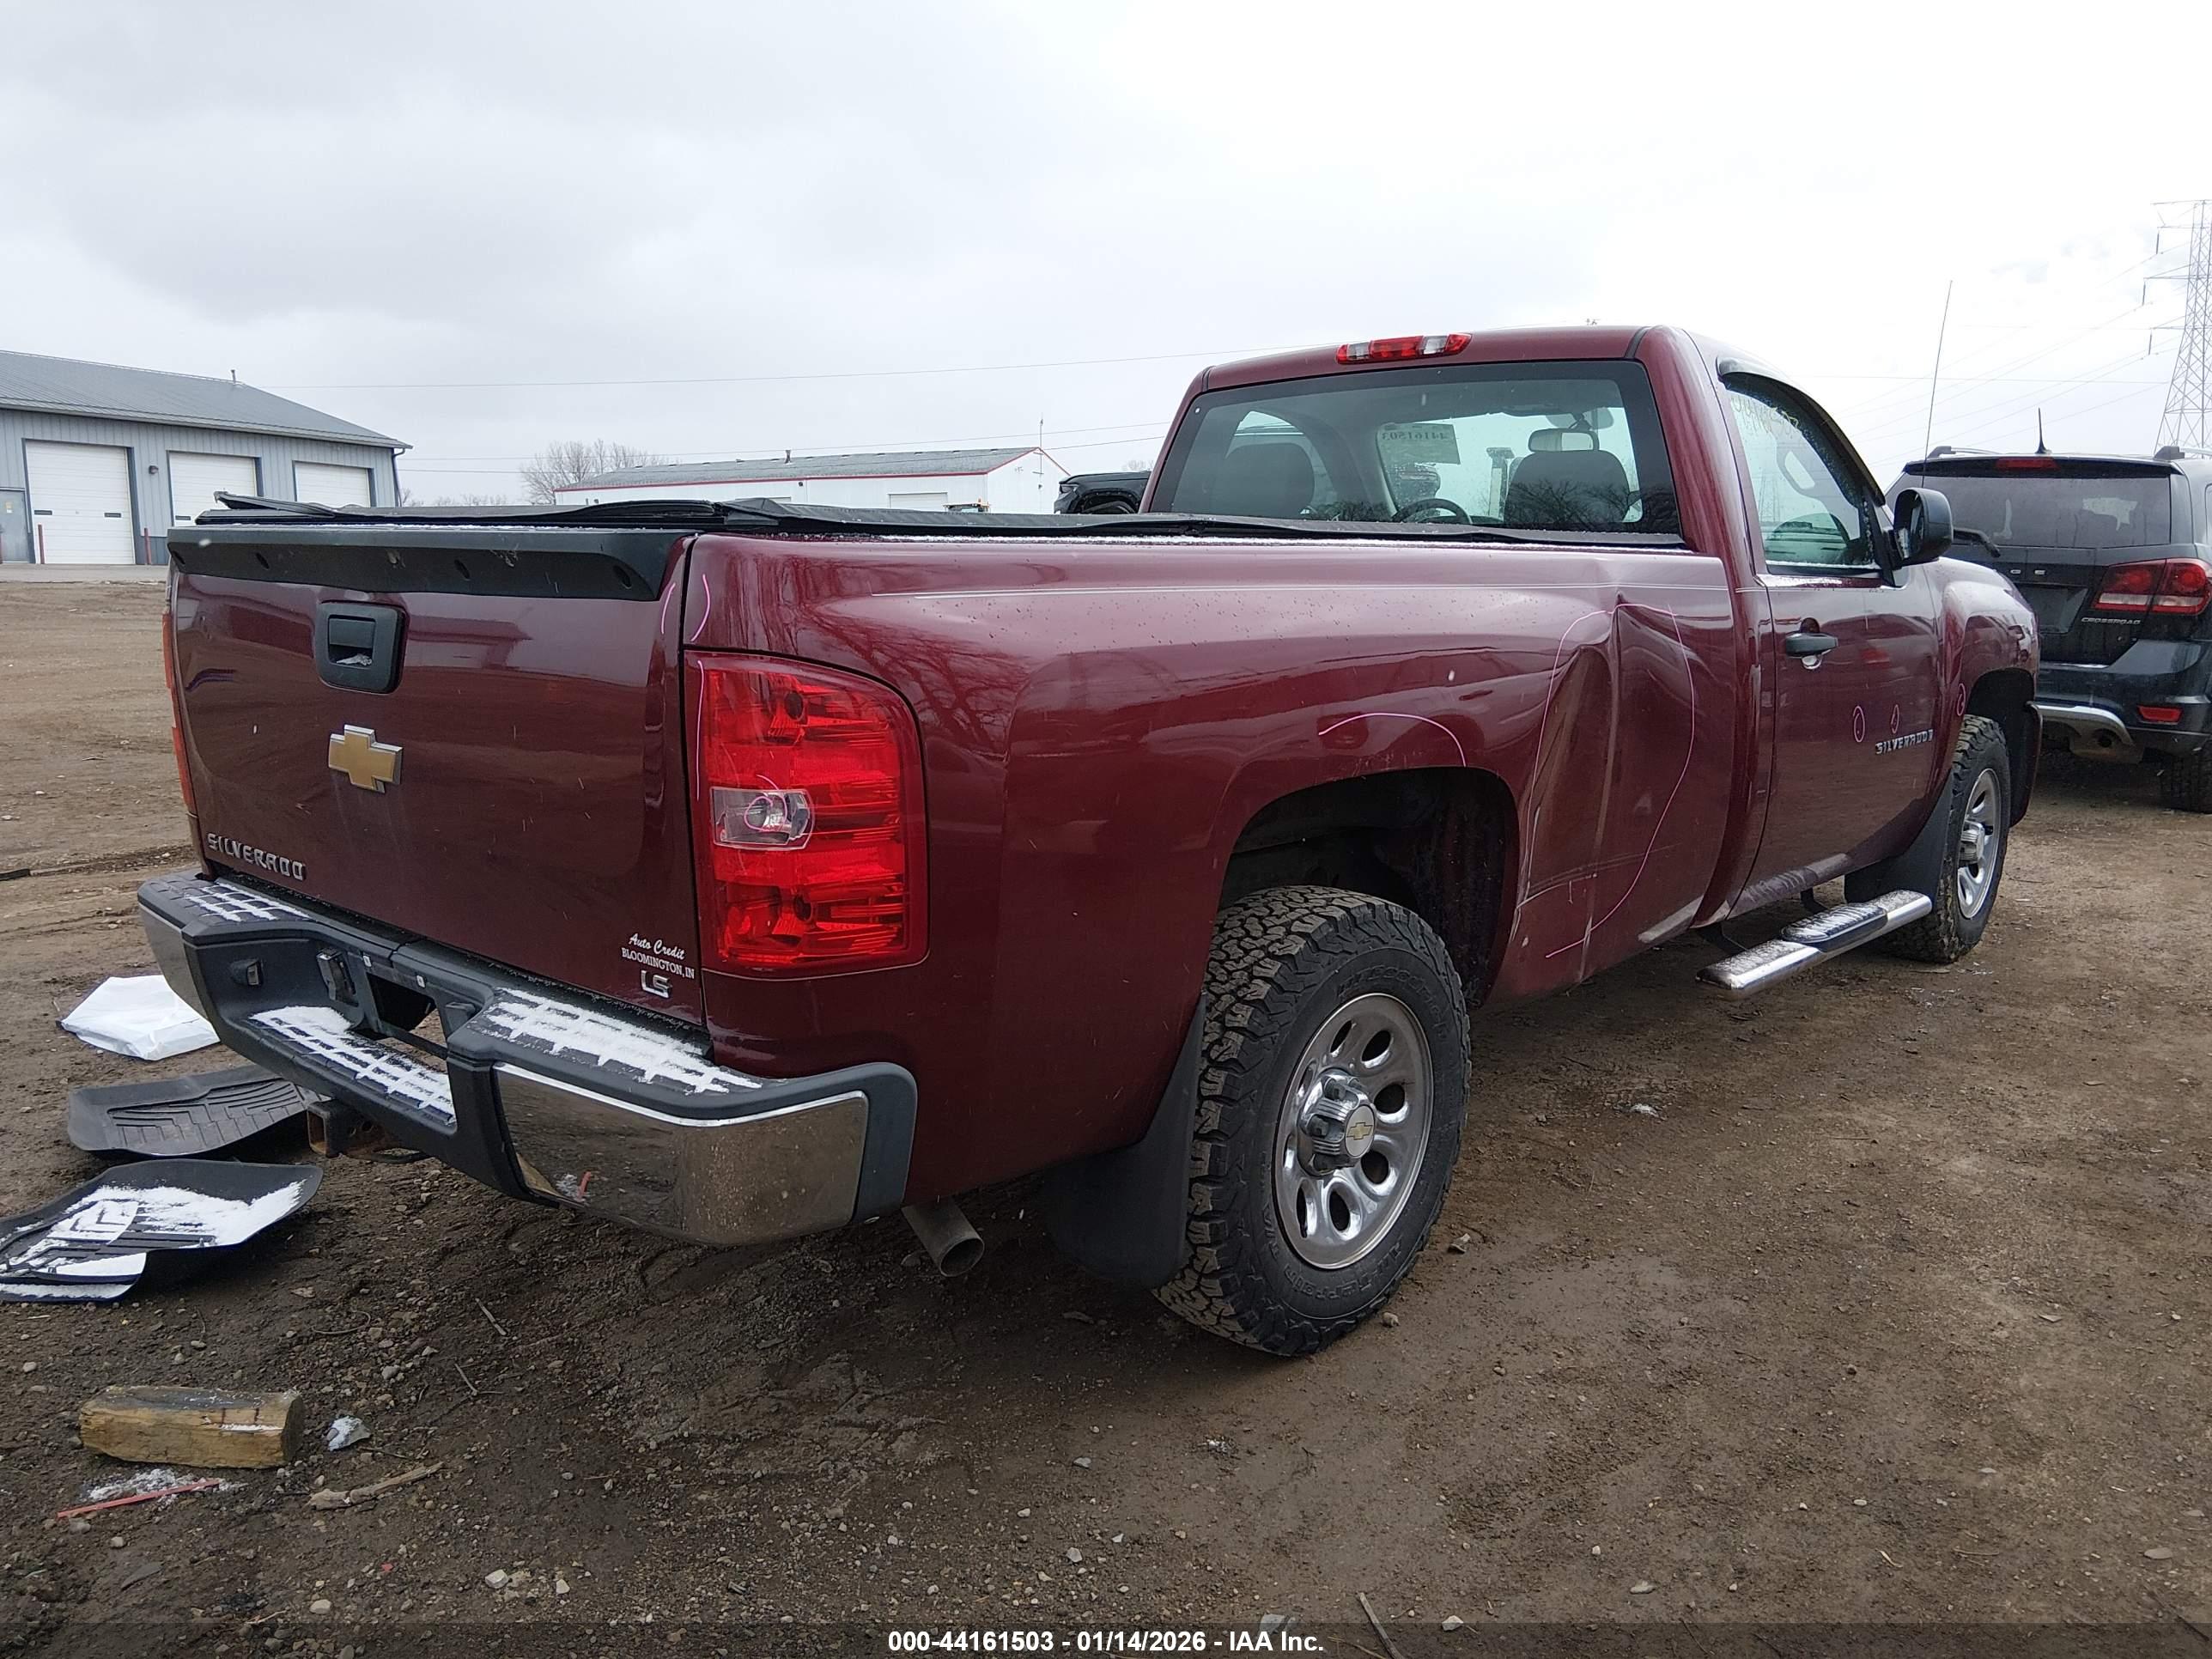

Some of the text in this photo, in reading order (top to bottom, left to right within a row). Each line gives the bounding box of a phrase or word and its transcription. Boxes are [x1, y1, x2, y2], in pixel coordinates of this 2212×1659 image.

[2081, 617, 2141, 625] CROSSROAD
[1875, 729, 1934, 755] SILVERADO
[207, 833, 304, 881] SILVERADO
[628, 933, 685, 960] Auto Credit
[641, 969, 670, 998] LS
